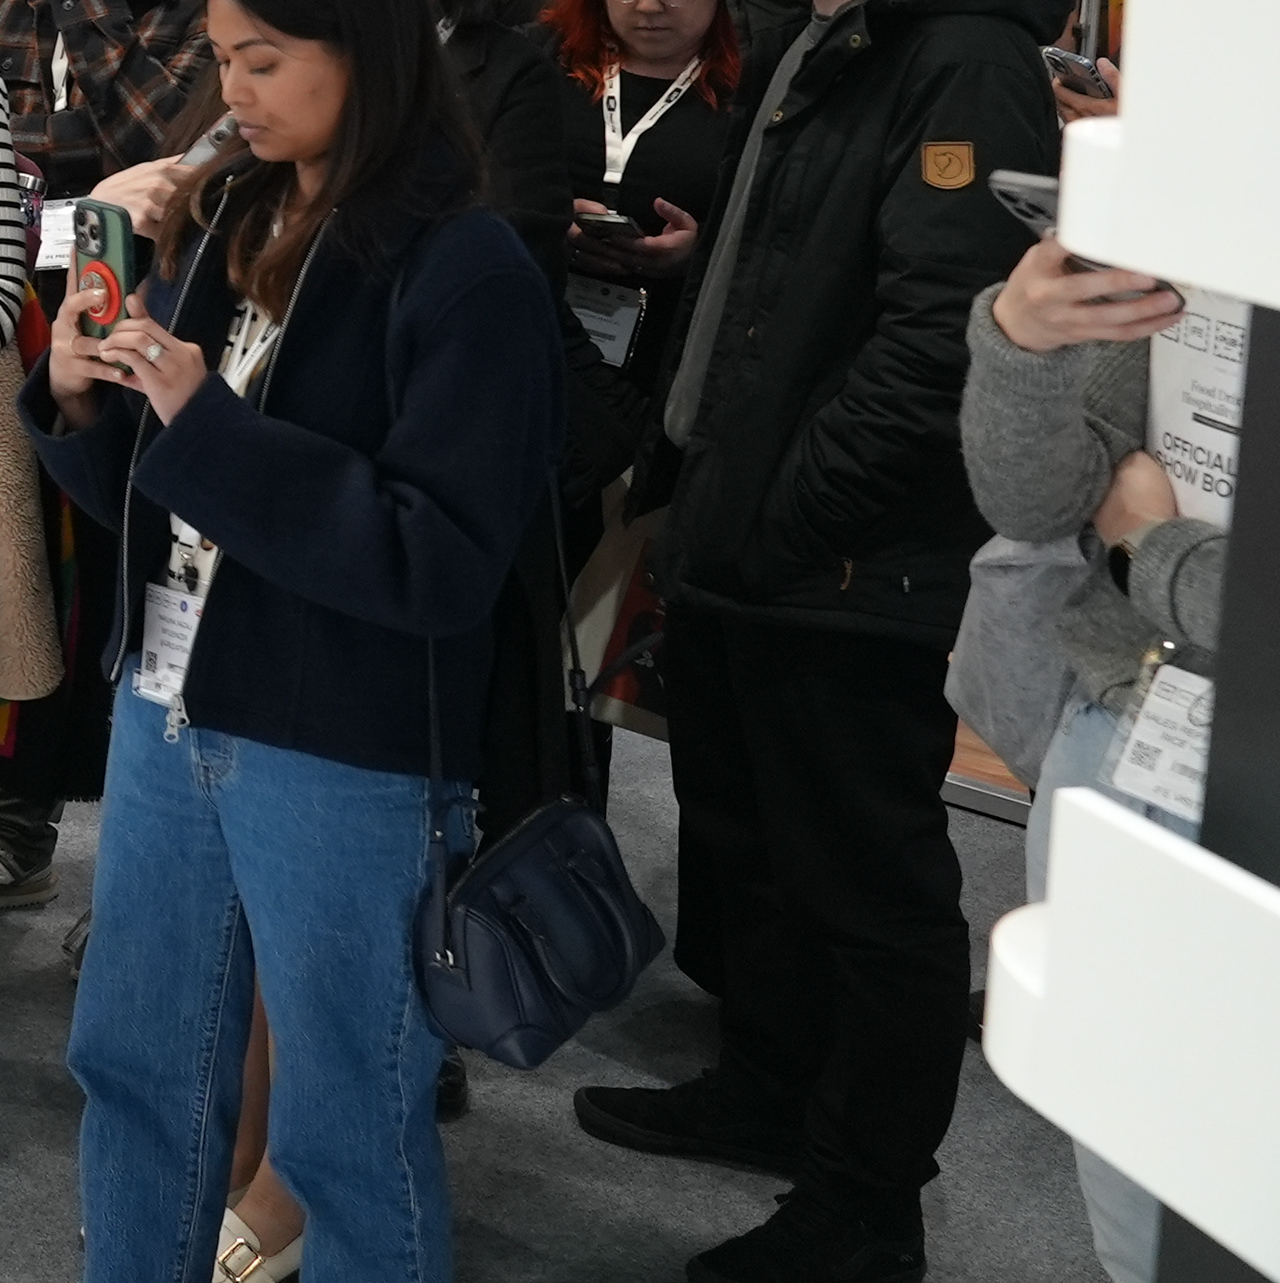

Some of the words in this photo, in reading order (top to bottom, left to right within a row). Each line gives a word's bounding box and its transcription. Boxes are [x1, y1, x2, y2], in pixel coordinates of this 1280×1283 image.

[1155, 451, 1197, 486] SHOW
[1202, 474, 1237, 498] BO
[1162, 432, 1237, 478] OFFICIAL
